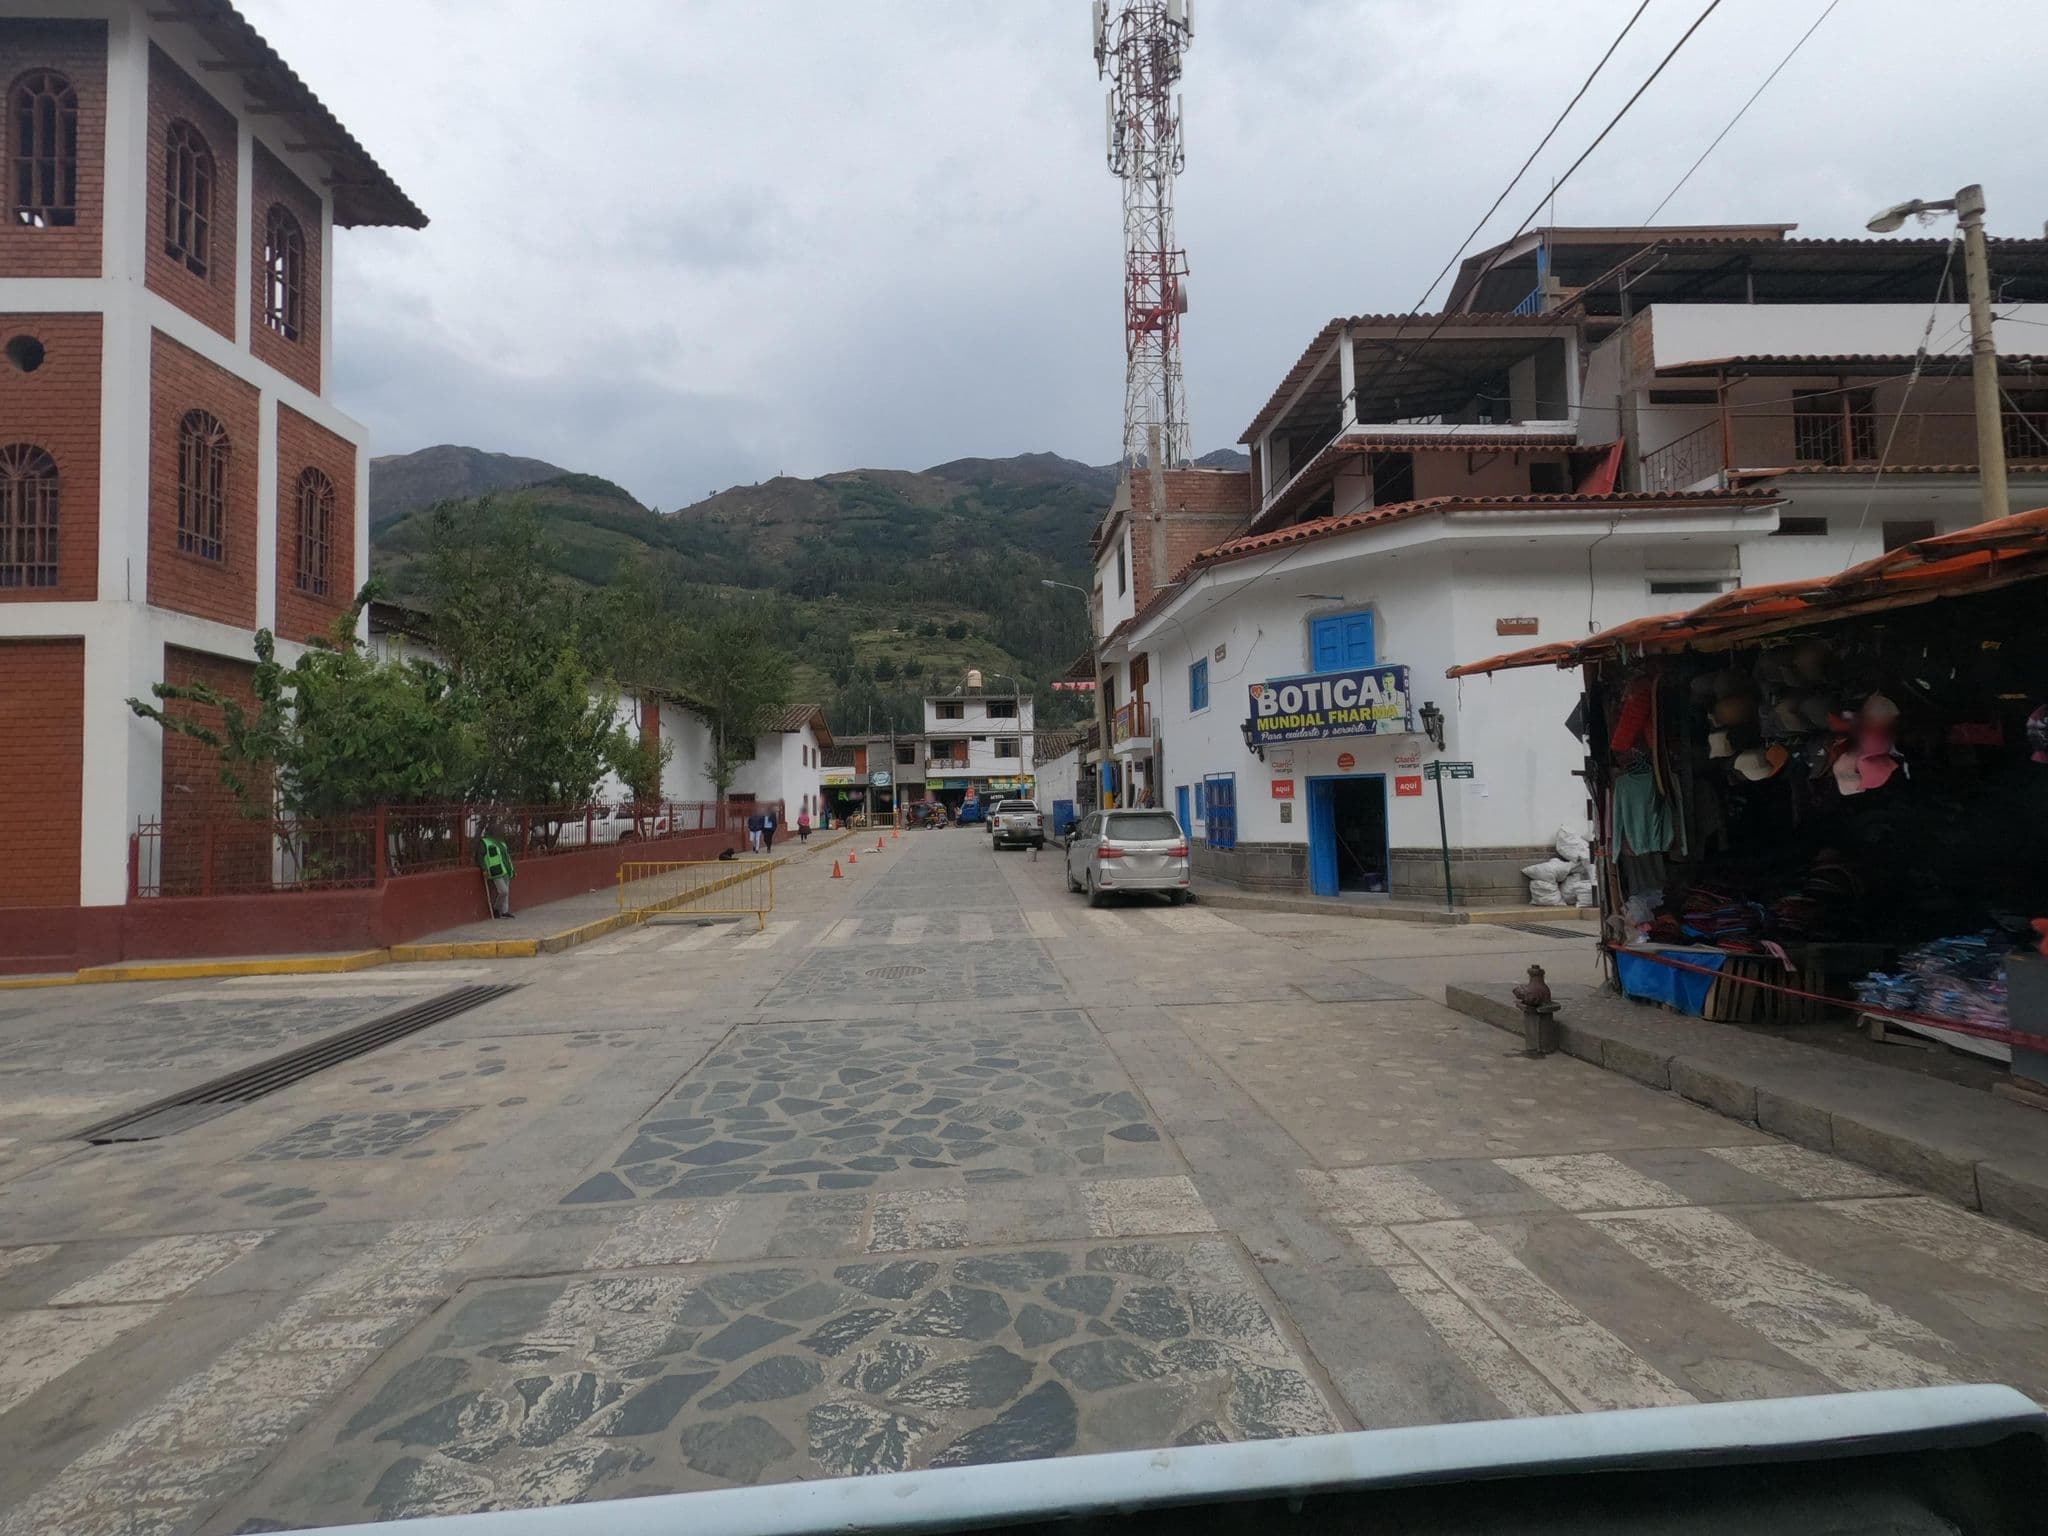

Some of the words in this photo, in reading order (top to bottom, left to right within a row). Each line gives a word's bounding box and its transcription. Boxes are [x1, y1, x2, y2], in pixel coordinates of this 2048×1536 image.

[1257, 675, 1384, 716] BOTICA
[1257, 711, 1325, 731] MUNDIAL
[1329, 704, 1399, 724] FHARMA
[1261, 731, 1283, 742] Para
[1285, 726, 1320, 739] cuidarte
